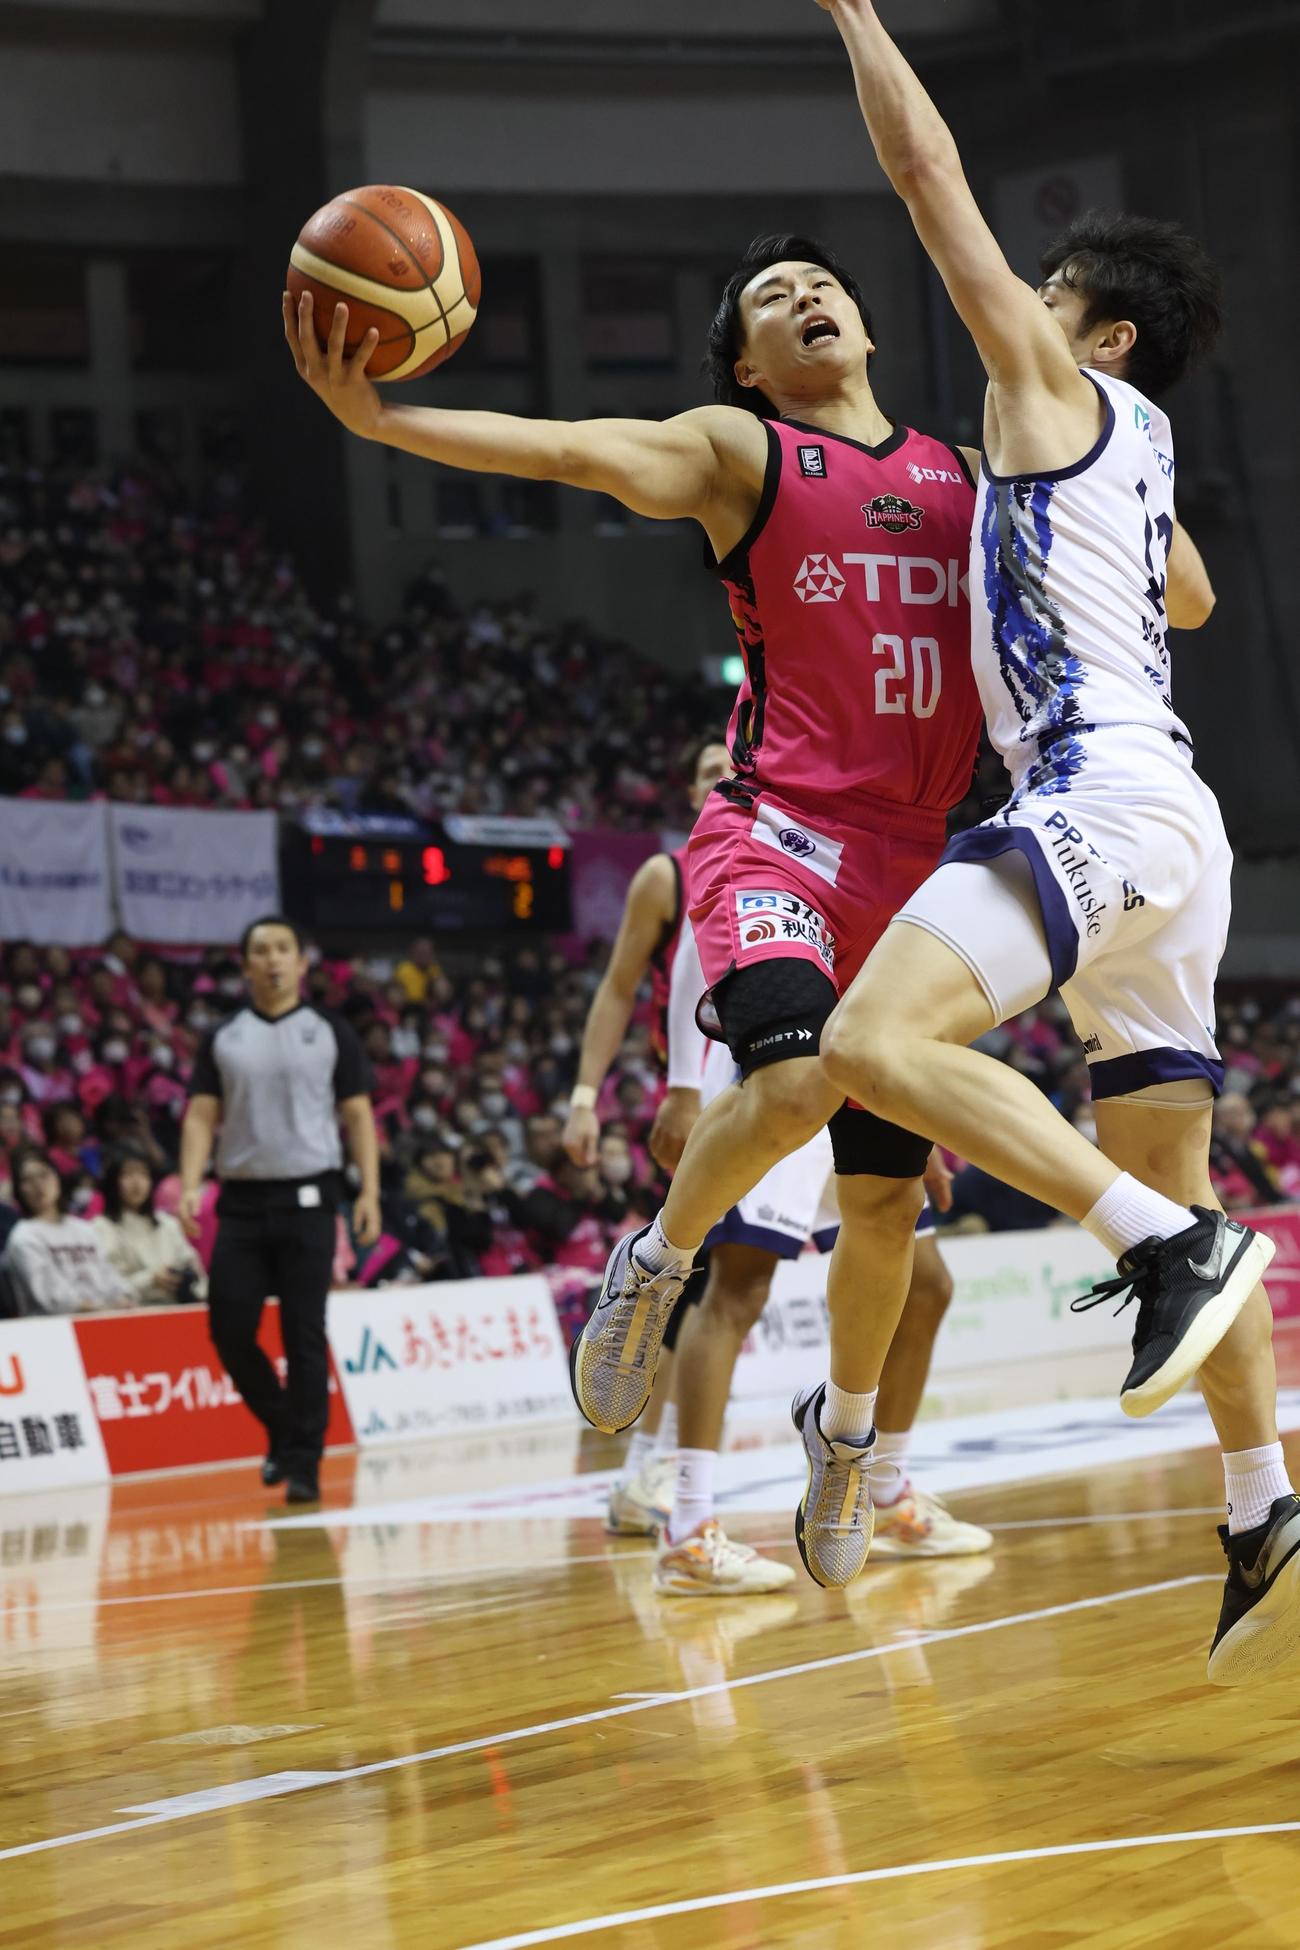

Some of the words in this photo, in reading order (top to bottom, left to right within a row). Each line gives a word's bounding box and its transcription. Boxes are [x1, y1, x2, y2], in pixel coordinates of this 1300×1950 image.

[868, 509, 919, 527] HAPPINETS
[842, 552, 971, 607] TDK
[872, 633, 942, 719] 20
[343, 1325, 398, 1374] JA
[0, 1413, 86, 1460] 自動車
